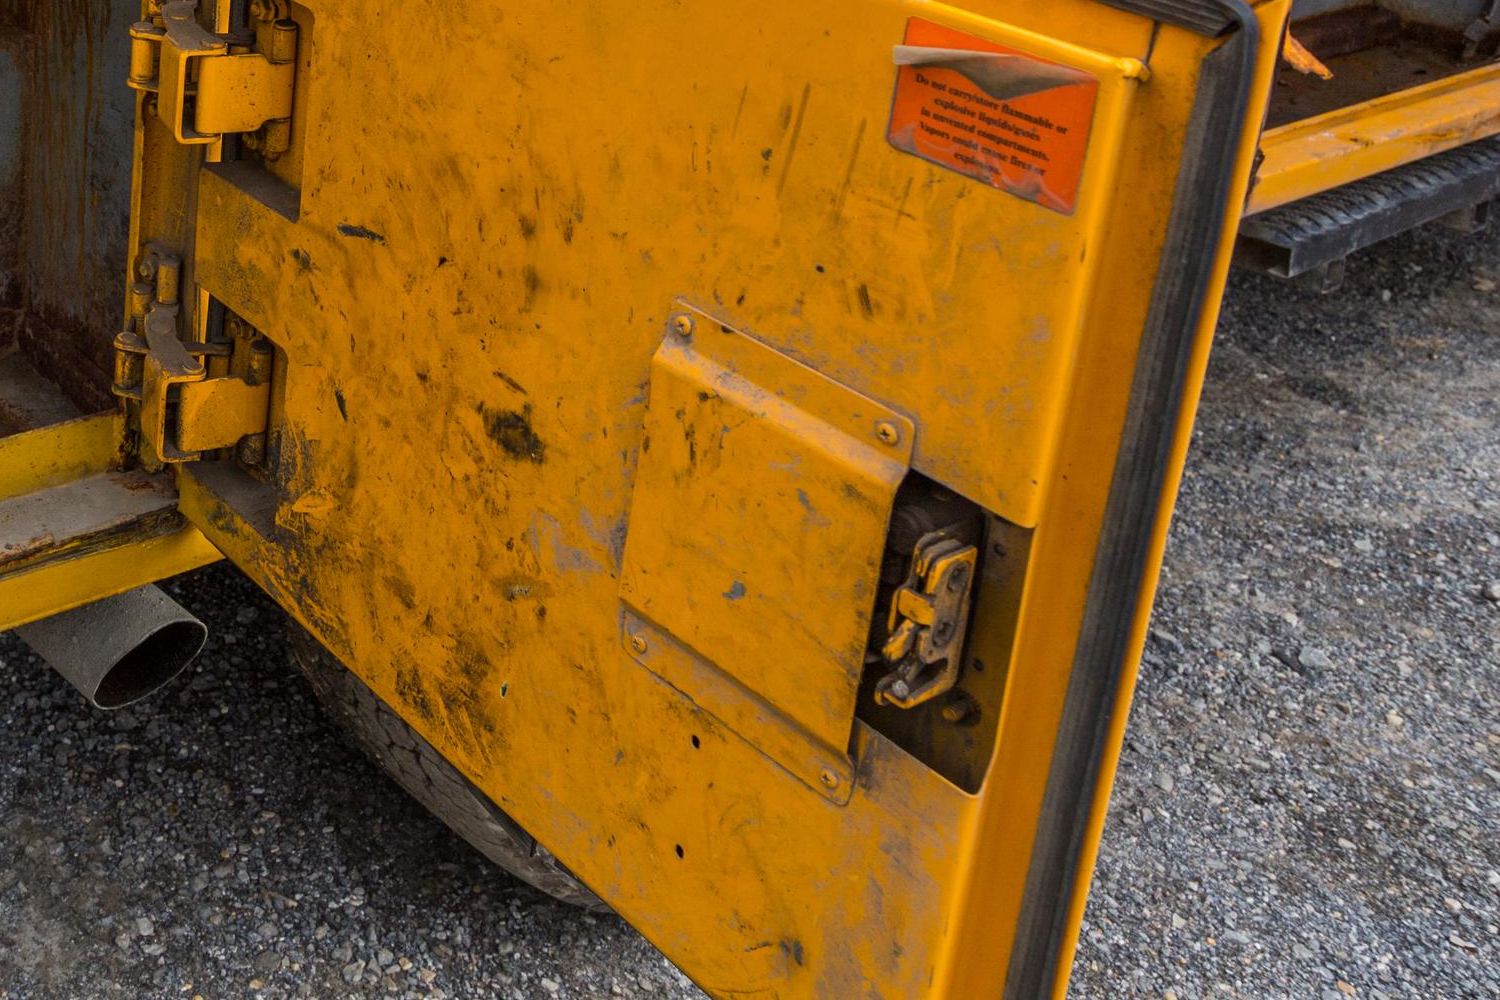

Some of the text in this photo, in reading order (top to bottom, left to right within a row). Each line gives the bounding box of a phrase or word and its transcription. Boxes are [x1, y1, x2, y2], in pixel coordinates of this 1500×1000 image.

[916, 73, 929, 85] Do
[931, 81, 947, 92] not
[1002, 103, 1054, 130] flammable
[1056, 126, 1069, 135] or
[933, 97, 977, 118] explosive
[919, 120, 950, 140] Vapors
[952, 135, 979, 151] could
[981, 146, 1008, 162] cause
[920, 106, 1049, 162] in unvented compartments.
